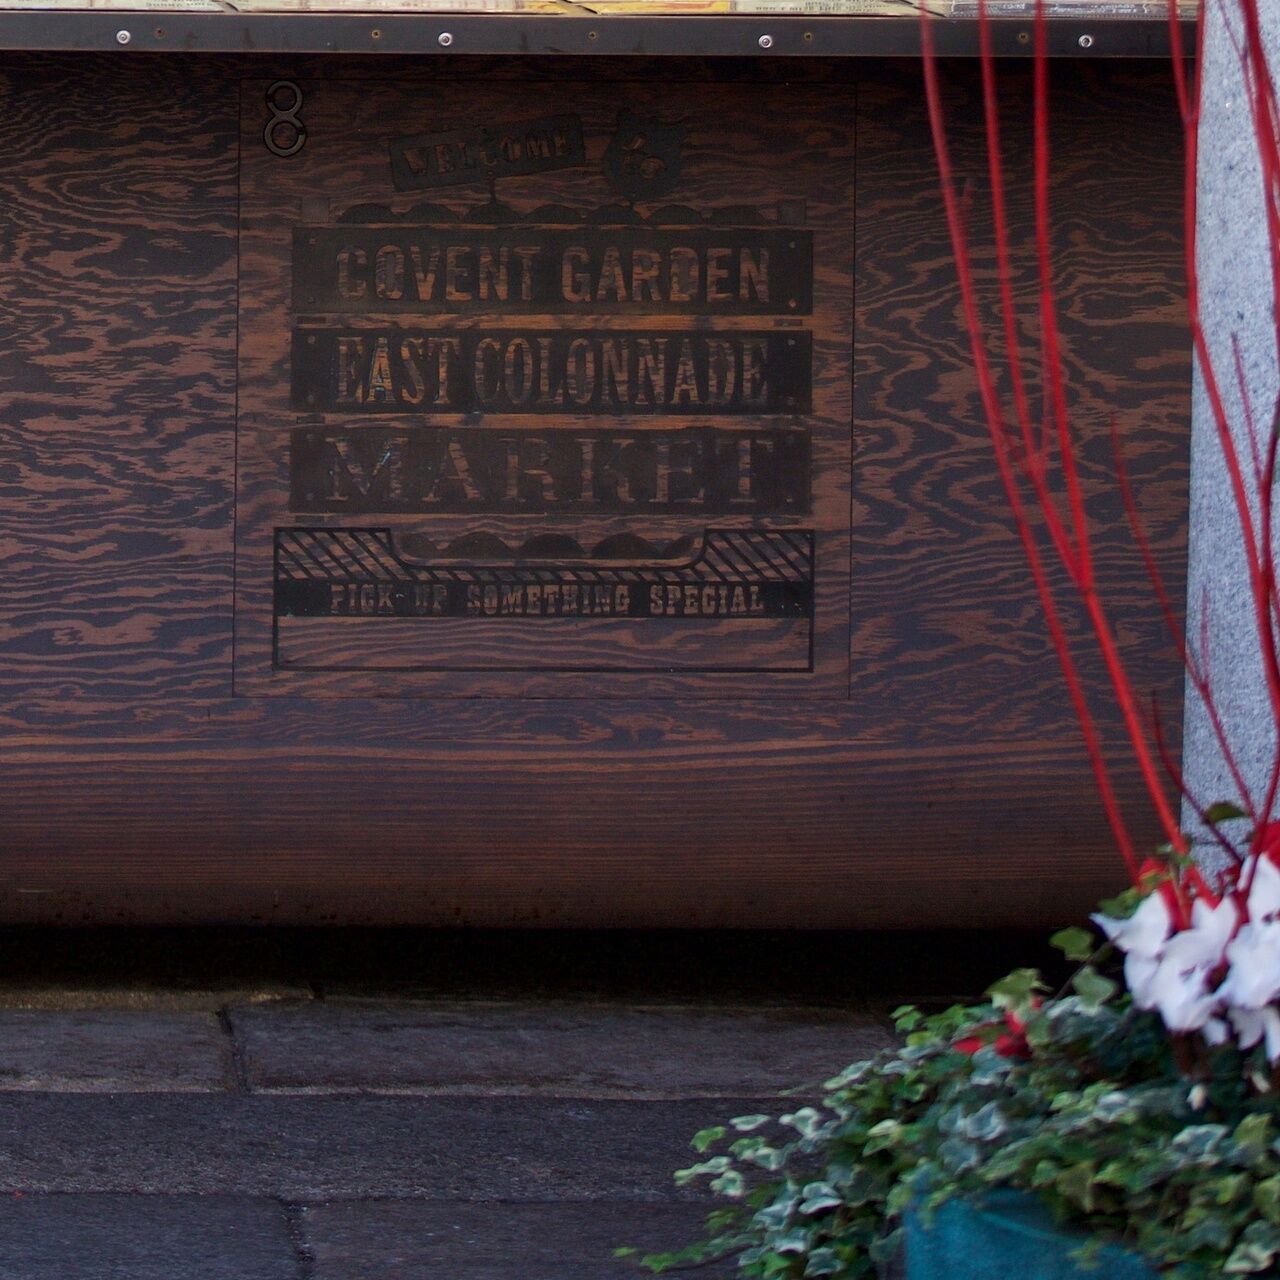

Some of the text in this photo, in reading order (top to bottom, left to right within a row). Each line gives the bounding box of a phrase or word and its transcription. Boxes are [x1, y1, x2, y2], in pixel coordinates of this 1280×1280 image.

[263, 80, 307, 157] 8
[335, 243, 771, 306] COVENT GARDEN
[335, 335, 770, 406] EAST COLONNADE
[325, 436, 780, 505] MARKET
[331, 583, 766, 616] PICK UP SOMETHING SPECIAL
